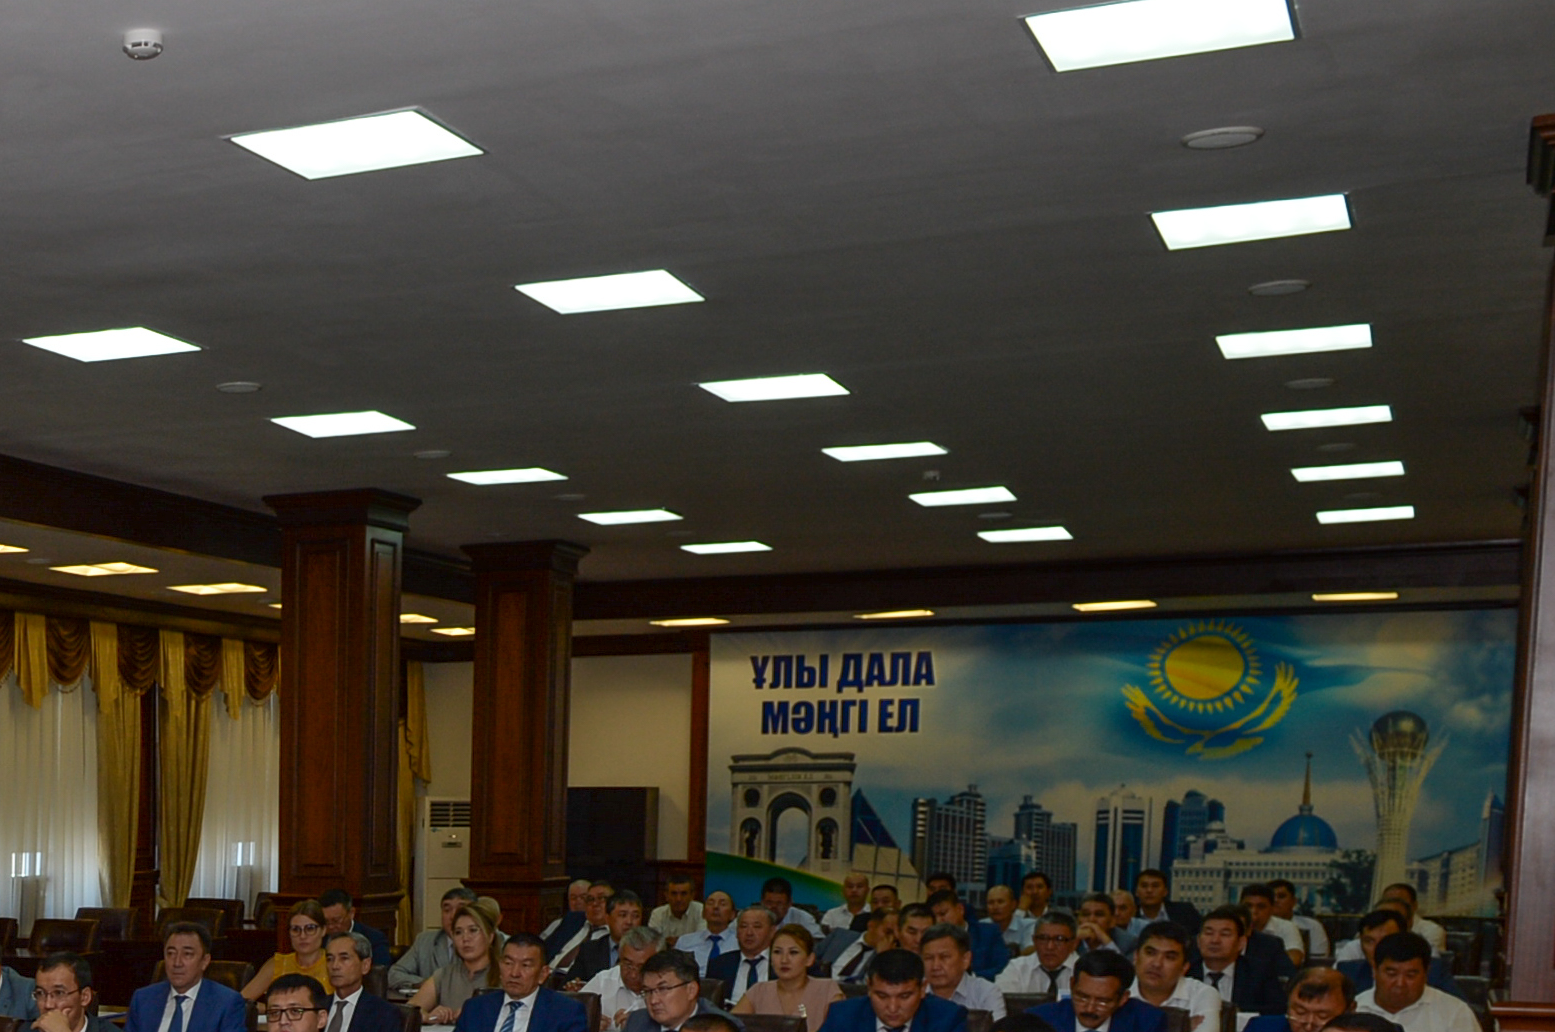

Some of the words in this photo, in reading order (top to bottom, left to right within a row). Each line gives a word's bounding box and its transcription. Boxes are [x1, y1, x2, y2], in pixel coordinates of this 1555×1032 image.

[750, 653, 829, 689] ҰЛЫ
[836, 651, 935, 693] ДАЛА
[761, 699, 868, 738] МӘҢГІ
[877, 698, 920, 733] ЕЛ
